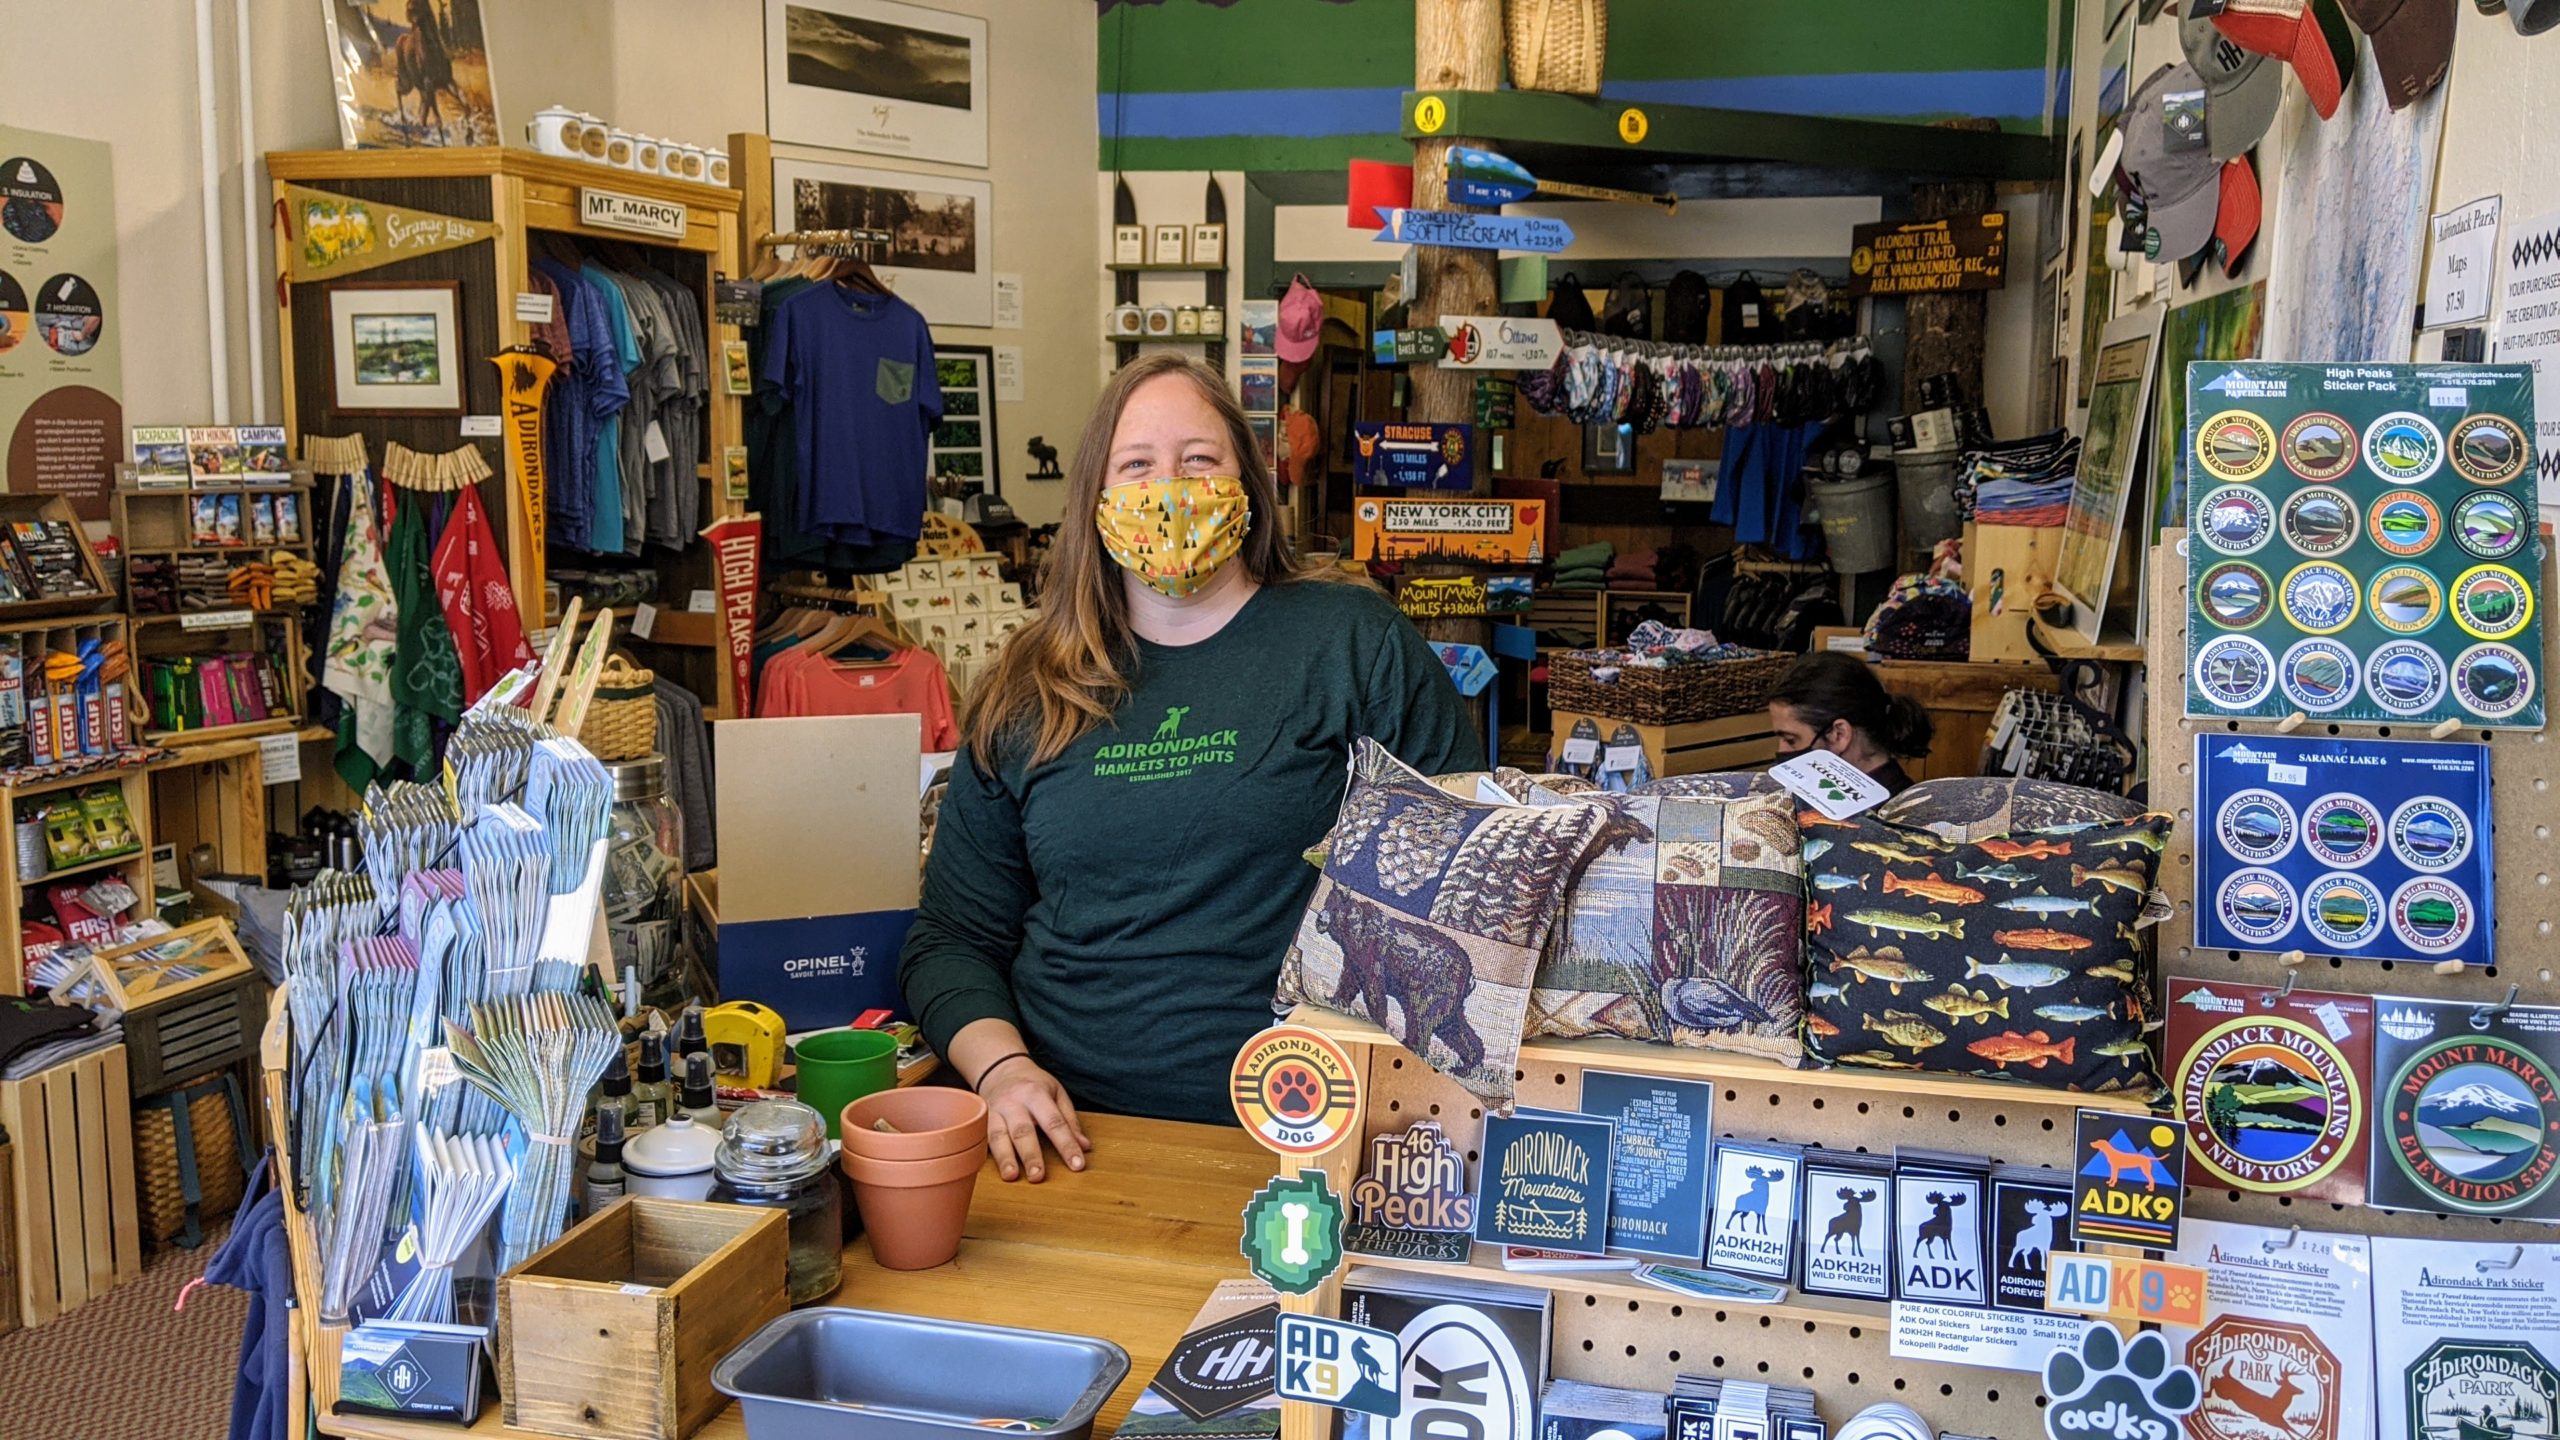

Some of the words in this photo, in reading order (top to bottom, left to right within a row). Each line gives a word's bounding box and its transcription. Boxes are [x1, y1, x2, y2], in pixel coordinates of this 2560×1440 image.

[589, 195, 616, 215] MT.
[623, 201, 681, 228] MARCY
[1405, 211, 1475, 226] DONNELLY'S
[386, 213, 443, 248] Saranac
[446, 220, 475, 241] Lake
[1405, 224, 1446, 242] SOFT
[2437, 212, 2472, 243] Adirondack
[2473, 206, 2496, 230] Park
[1874, 233, 1920, 249] KLONDIKE
[1923, 231, 1952, 246] TRAIL
[1895, 248, 1913, 262] VAN
[1916, 245, 1956, 261] LEAN-TO
[2447, 255, 2468, 279] Maps
[1870, 278, 1897, 294] AREA
[1898, 274, 1940, 291] PARKING
[1942, 273, 1963, 288] LOT
[2509, 280, 2527, 298] YOUR
[2446, 289, 2465, 314] $7.50
[2506, 310, 2519, 324] THE
[2518, 303, 2548, 323] CREATION
[1499, 320, 1538, 345] Ottawa
[2326, 368, 2354, 379] High
[2357, 368, 2393, 379] Peaks
[2323, 381, 2365, 391] Sticker
[2367, 381, 2397, 392] Pack
[137, 430, 181, 442] BACKPACKING
[190, 430, 204, 442] DAY
[205, 430, 233, 442] HIKING
[241, 429, 283, 442] CAMPING
[1384, 425, 1432, 440] SYRACUSE
[2458, 420, 2495, 439] PANTHER
[2496, 421, 2516, 440] PEAK
[510, 400, 542, 535] ADIRONDACKS
[1392, 453, 1404, 464] 133
[1405, 453, 1427, 464] MILES
[1388, 506, 1425, 518] NEW
[1428, 506, 1472, 518] YORK
[1476, 506, 1508, 518] CITY
[2229, 490, 2270, 524] SKYLIGHT
[1413, 519, 1439, 527] MILES
[1486, 519, 1506, 528] FEET
[720, 535, 756, 590] HIGH
[1400, 583, 1444, 601] MOUNT
[1445, 583, 1488, 601] MARCY
[2457, 571, 2488, 601] MACOMB
[1410, 603, 1441, 617] MILES
[728, 594, 753, 657] PEAKS
[2204, 641, 2229, 663] LOWER
[2317, 643, 2351, 667] EMMONS
[2395, 646, 2439, 676] DONALDSON
[1094, 729, 1239, 760] ADIRONDACK
[1094, 759, 1165, 776] HAMLETS
[1168, 755, 1189, 768] TO
[1192, 750, 1235, 765] HUTS
[2298, 753, 2348, 764] SARANAC
[2350, 754, 2377, 765] LAKE
[2379, 756, 2387, 765] 6
[1129, 771, 1175, 783] ESTABLISHED
[1175, 768, 1193, 778] 2017
[2225, 795, 2260, 830] AMPERSAND
[2310, 799, 2335, 824] BAKER
[2396, 802, 2430, 836] HAYSTACK
[2309, 878, 2343, 910] SCARFACE
[783, 955, 851, 972] OPINEL
[790, 970, 814, 979] SAVOIE
[817, 967, 844, 976] FRANCE
[1248, 1039, 1340, 1075] ADIRONDACK
[2187, 1026, 2274, 1125] ADIRONDACK
[2279, 1030, 2351, 1140] MOUNTAINS
[2402, 1045, 2480, 1096] MOUNT
[2485, 1046, 2556, 1104] MARCY
[1276, 1127, 1315, 1143] DOG
[1406, 1130, 1434, 1154] 46
[1622, 1135, 1655, 1147] EMBRACE
[1501, 1131, 1590, 1186] ADIRONDACK
[1634, 1146, 1668, 1160] JOURNEY
[2206, 1143, 2258, 1179] NEW
[2259, 1152, 2322, 1182] YORK
[1374, 1141, 1455, 1196] High
[2400, 1134, 2518, 1202] ELEVATION
[1500, 1176, 1586, 1204] Mountains
[1355, 1182, 1472, 1228] Peaks
[2080, 1187, 2175, 1222] ADK9
[1358, 1228, 1431, 1244] PADDLE
[1715, 1233, 1784, 1256] ADKH2H
[1364, 1241, 1396, 1253] THE
[1397, 1242, 1461, 1260] DACKS
[1713, 1249, 1784, 1267] ADIRONDACKS
[2207, 1243, 2270, 1268] Adirondack
[2272, 1258, 2295, 1271] Park
[2297, 1261, 2330, 1275] Sticker
[1811, 1258, 1882, 1277] ADKH2H
[1812, 1270, 1836, 1281] WILD
[1837, 1272, 1882, 1285] FOREVER
[1907, 1264, 1978, 1292] ADK
[2418, 1266, 2483, 1288] Adirondack
[2486, 1277, 2509, 1288] Park
[2511, 1278, 2545, 1289] Sticker
[2000, 1285, 2047, 1299] FOREVER
[2057, 1262, 2166, 1313] ADK9
[1899, 1315, 1918, 1324] ADK
[1918, 1317, 1937, 1326] Oval
[1938, 1319, 1970, 1330] Stickers
[1980, 1324, 2004, 1334] Large
[2005, 1326, 2028, 1336] $3.00
[2033, 1329, 2056, 1339] Small
[2058, 1332, 2080, 1342] $1.50
[1900, 1304, 1921, 1313] PURE
[1922, 1306, 1941, 1315] ADK
[1942, 1308, 1985, 1320] COLORFUL
[1987, 1313, 2025, 1323] STICKERS
[2033, 1317, 2055, 1327] $3.25
[2057, 1320, 2080, 1330] EACH
[1287, 1323, 1340, 1361] AD
[1899, 1327, 1934, 1337] ADKH2H
[1935, 1330, 1983, 1343] Rectangular
[1985, 1336, 2018, 1347] Stickers
[1899, 1338, 1937, 1349] Kokopelli
[1938, 1343, 1970, 1353] Paddler
[2198, 1331, 2329, 1383] ADIRONDACK
[1286, 1358, 1339, 1397] K9
[2239, 1361, 2273, 1384] PARK
[2417, 1354, 2556, 1399] ADIRONDACK
[2459, 1380, 2516, 1396] PARK
[2060, 1399, 2168, 1440] adk9
